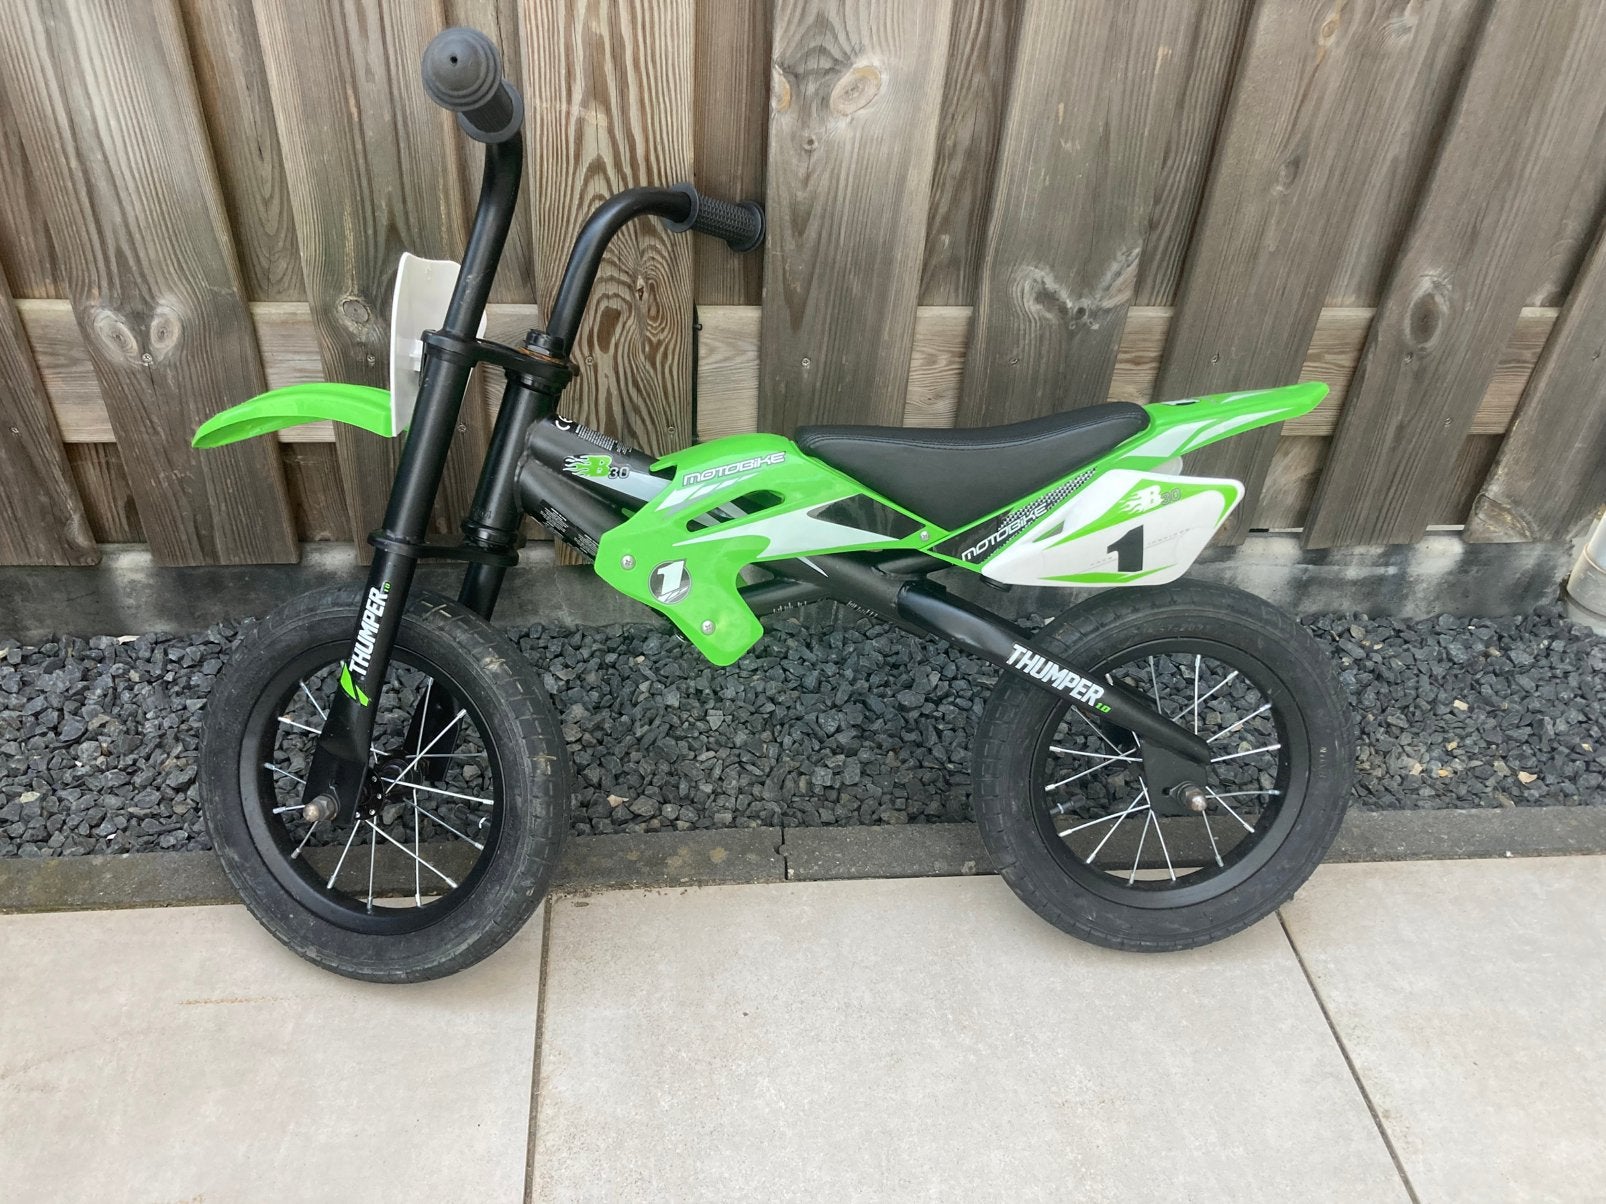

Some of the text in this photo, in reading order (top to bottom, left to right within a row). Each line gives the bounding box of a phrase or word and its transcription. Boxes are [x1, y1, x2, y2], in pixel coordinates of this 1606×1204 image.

[1106, 524, 1144, 573] 1
[656, 559, 685, 596] 1
[348, 586, 389, 676] THUMPER
[1006, 643, 1105, 707] THUMPER
